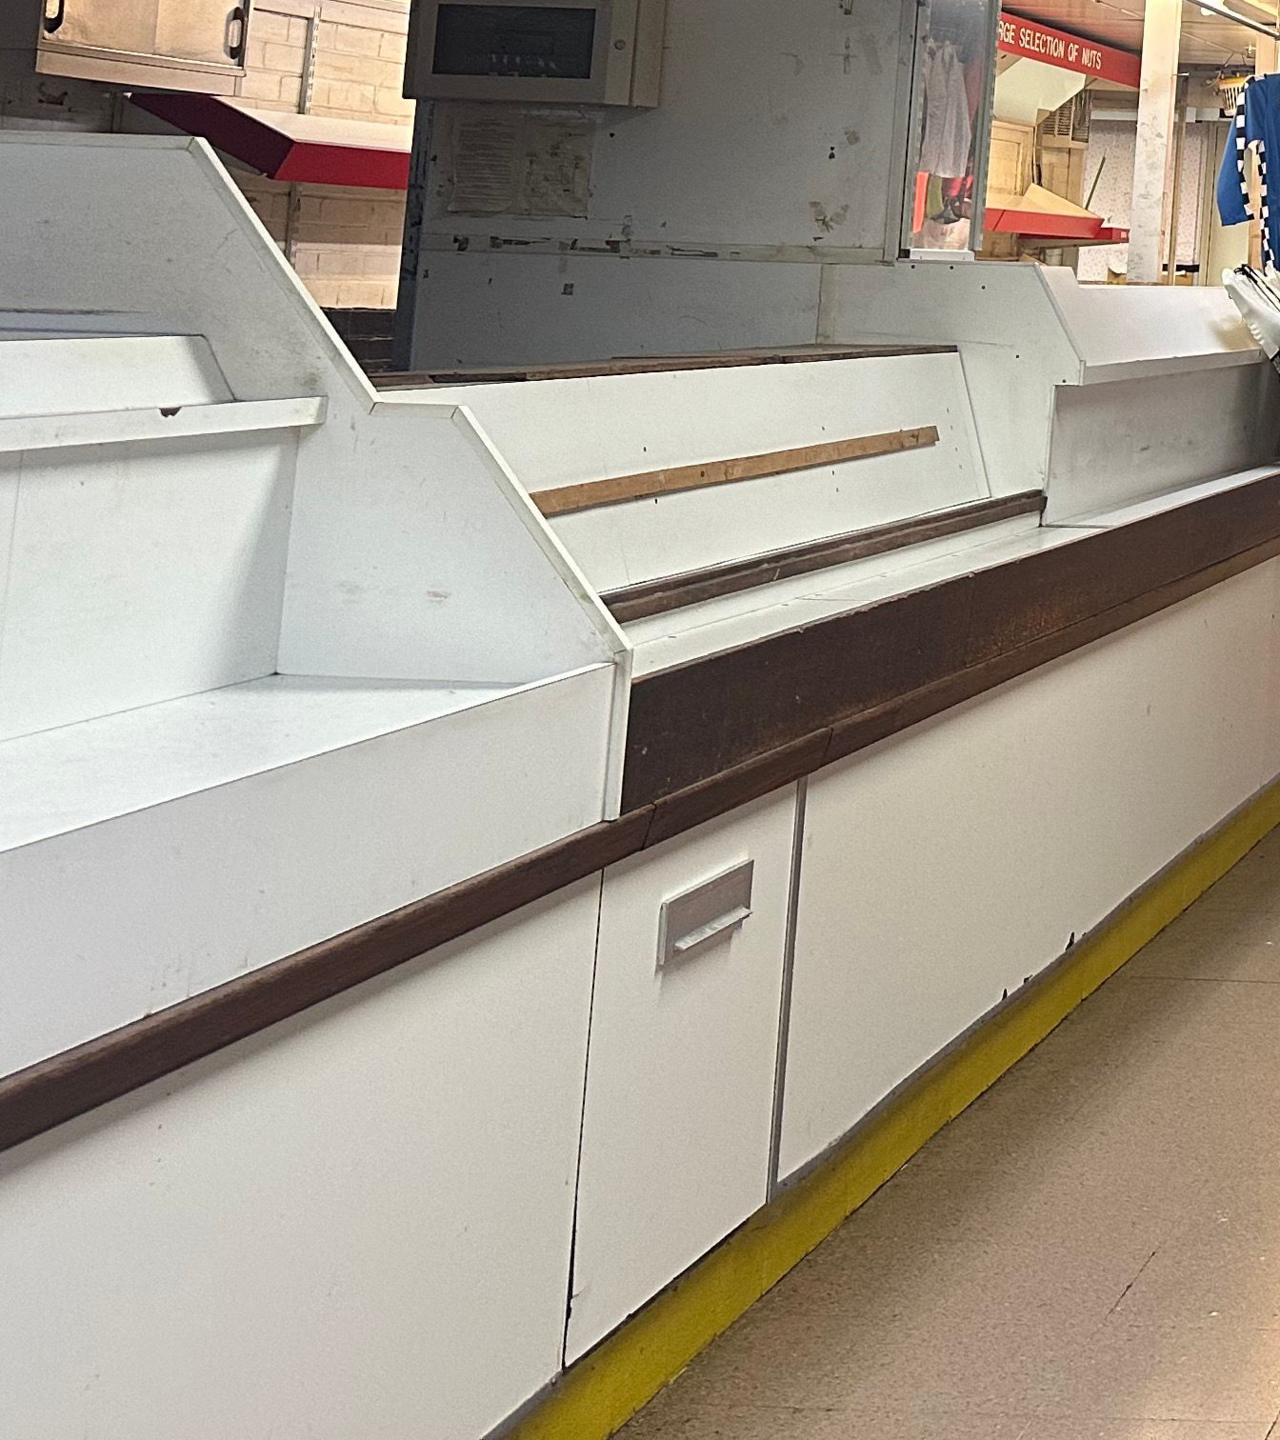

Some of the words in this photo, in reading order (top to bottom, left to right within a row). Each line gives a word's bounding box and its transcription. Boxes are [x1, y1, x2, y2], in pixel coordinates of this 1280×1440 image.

[1019, 27, 1066, 60] SELECTION
[1067, 42, 1080, 63] OF
[1081, 47, 1102, 70] NUTS
